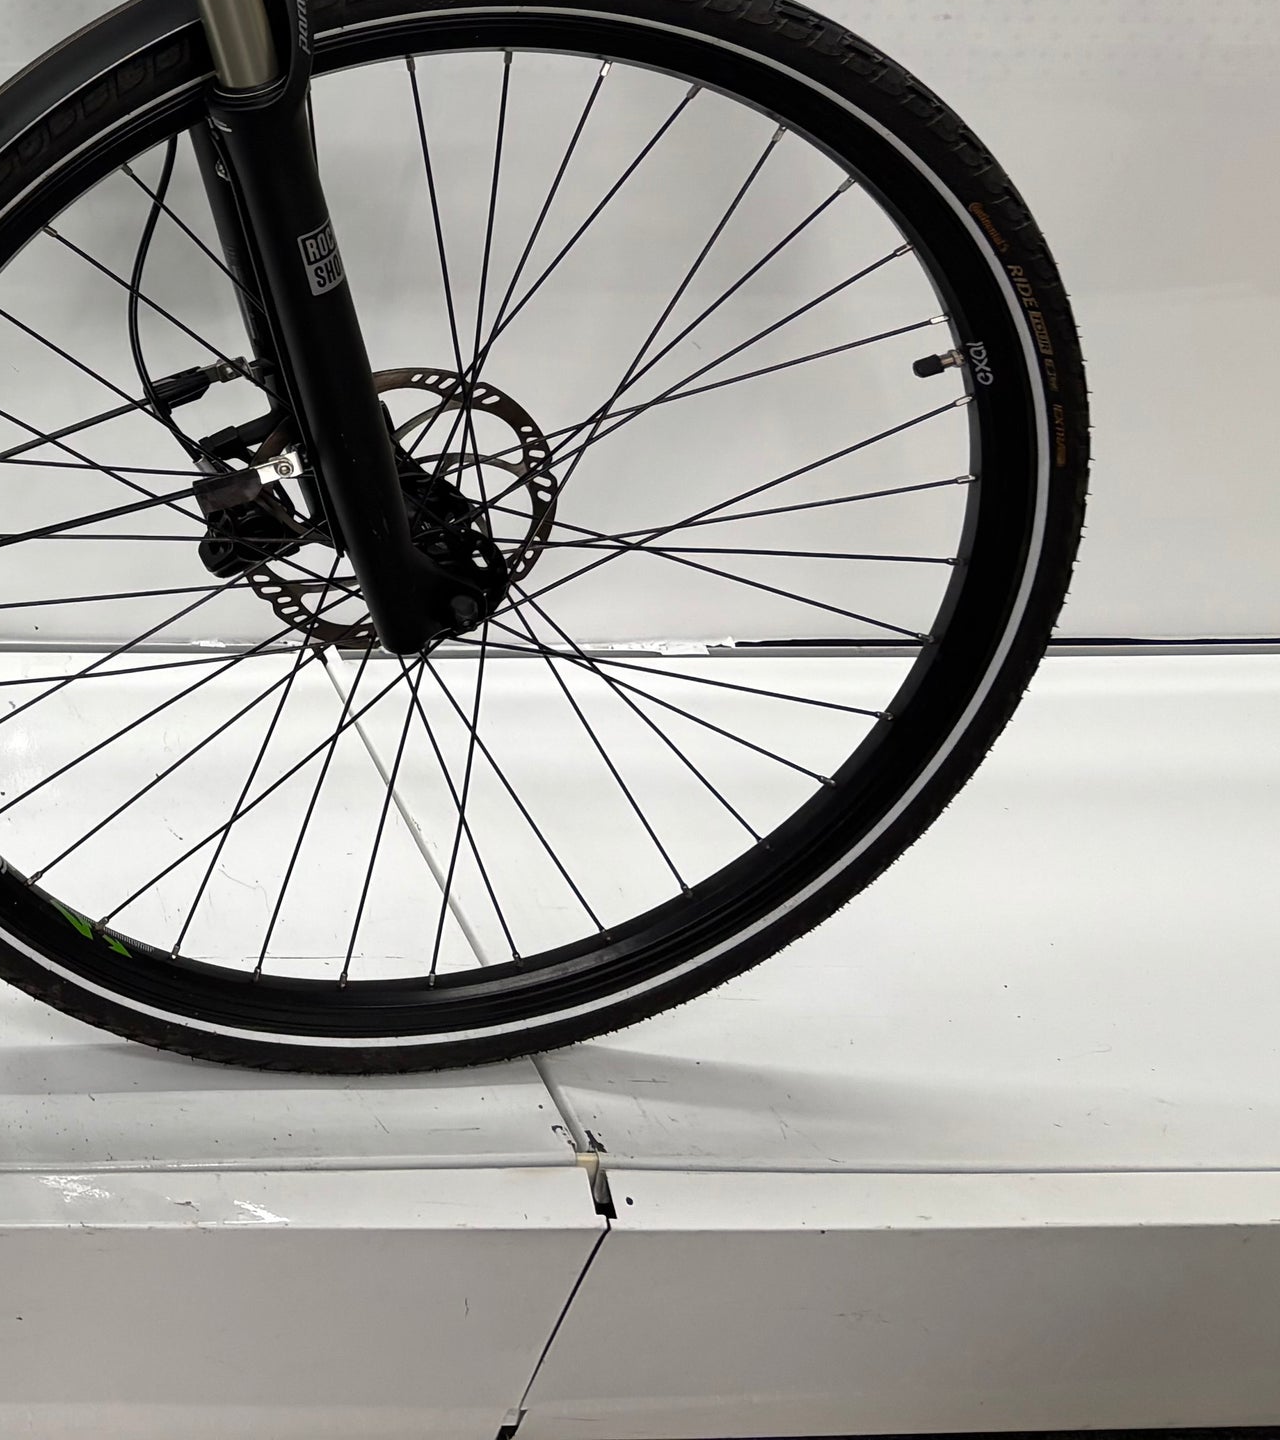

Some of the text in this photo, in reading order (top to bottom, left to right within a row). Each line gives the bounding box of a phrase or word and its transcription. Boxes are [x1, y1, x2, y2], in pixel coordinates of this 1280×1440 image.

[305, 226, 336, 262] ROC
[313, 254, 342, 288] SHO
[1007, 264, 1040, 309] RIDE
